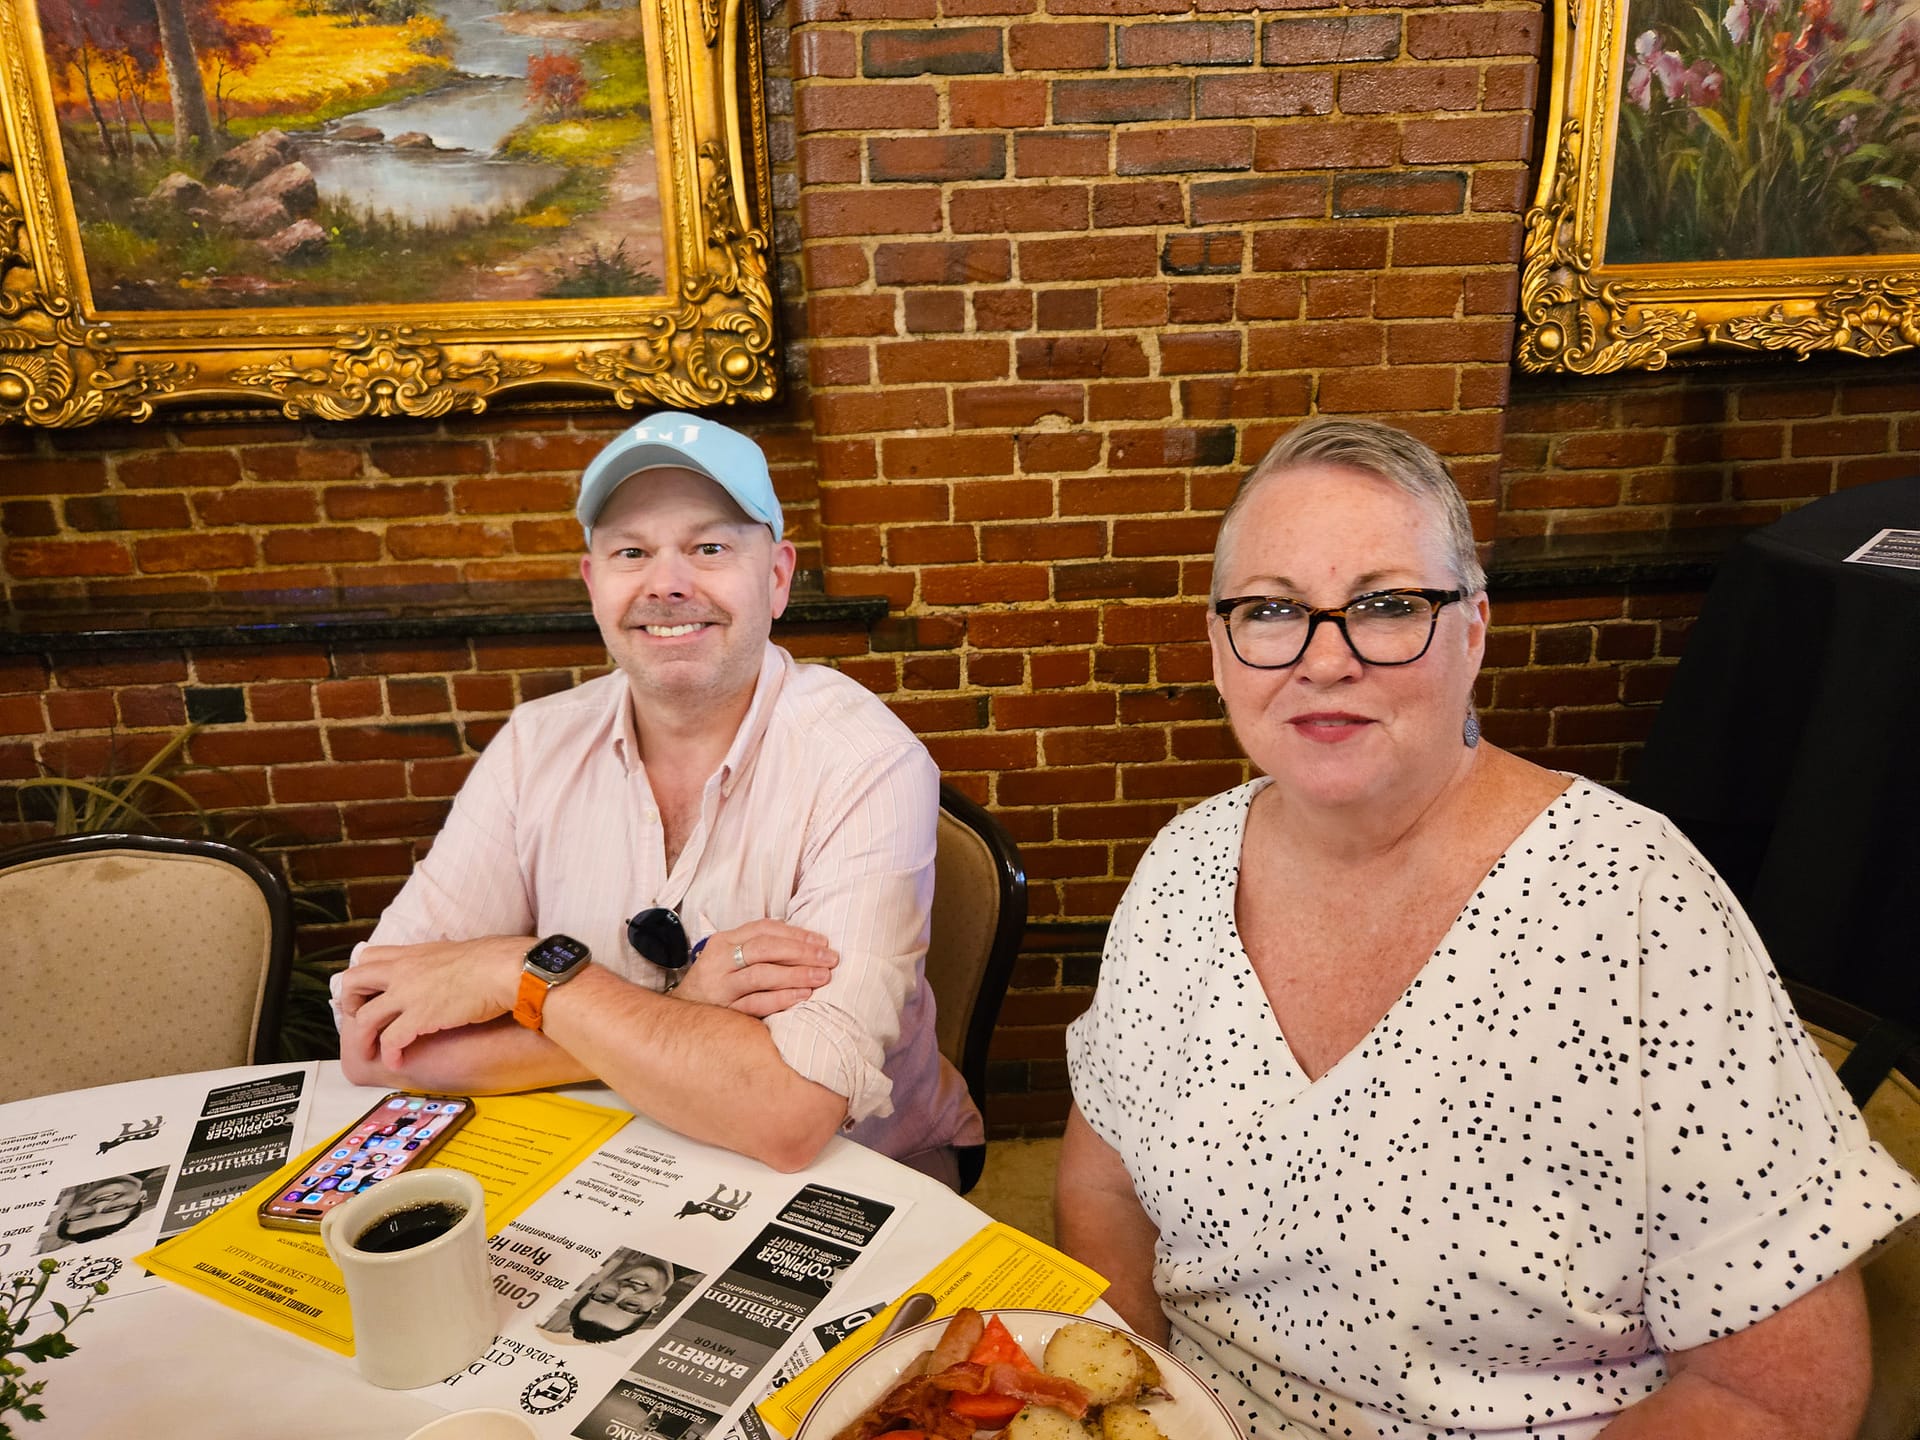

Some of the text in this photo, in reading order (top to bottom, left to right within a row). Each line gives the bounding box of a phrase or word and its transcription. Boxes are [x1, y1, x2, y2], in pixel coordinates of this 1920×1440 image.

[206, 1116, 284, 1140] COPPINGER
[208, 1113, 262, 1130] SHERIFF
[237, 1129, 262, 1138] Kevin
[180, 1146, 288, 1176] Hamilton
[188, 1141, 284, 1165] State Representative
[598, 1150, 640, 1170] Berthiaume
[660, 1158, 676, 1166] Joe
[234, 1158, 263, 1169] Ryan
[639, 1165, 661, 1176] Nolet
[609, 1172, 640, 1186] Bill Cox
[662, 1171, 683, 1180] Julie
[202, 1184, 247, 1198] MAYOR
[576, 1180, 618, 1198] Bevilacqua
[14, 1199, 46, 1210] State
[174, 1191, 244, 1214] RRETT
[618, 1194, 644, 1206] Louise
[181, 1208, 217, 1220] NDA
[2, 1225, 34, 1238] 2026
[508, 1220, 602, 1260] State Representative
[487, 1234, 552, 1266] Ryan Ha
[767, 1236, 820, 1260] SHERIFF
[818, 1251, 842, 1262] COUNTY
[224, 1245, 346, 1295] OFFICIAL STRAW POLL BALLOT
[504, 1259, 544, 1281] Elected
[756, 1245, 832, 1279] COPPINGER
[542, 1274, 570, 1290] 2026
[770, 1266, 805, 1282] Kevin F.
[194, 1262, 323, 1318] HAVERHILL DEMOCRATIC CITY COMMITTEE
[492, 1274, 540, 1310] Cong
[943, 1271, 972, 1296] QUESTIONS
[719, 1282, 806, 1313] State Representative
[703, 1289, 804, 1332] Hamilton
[746, 1312, 774, 1328] Ryan
[504, 1336, 525, 1354] Roz
[694, 1336, 736, 1356] MAYOR
[481, 1349, 515, 1367] CIT
[526, 1346, 555, 1364] 2026
[658, 1340, 749, 1378] BARRETT
[657, 1357, 727, 1387] MELINDA
[635, 1377, 658, 1388] SUPPORT
[658, 1385, 671, 1393] YOUR
[620, 1388, 707, 1424] DELIVERING RESULTS
[678, 1392, 696, 1402] COUNT
